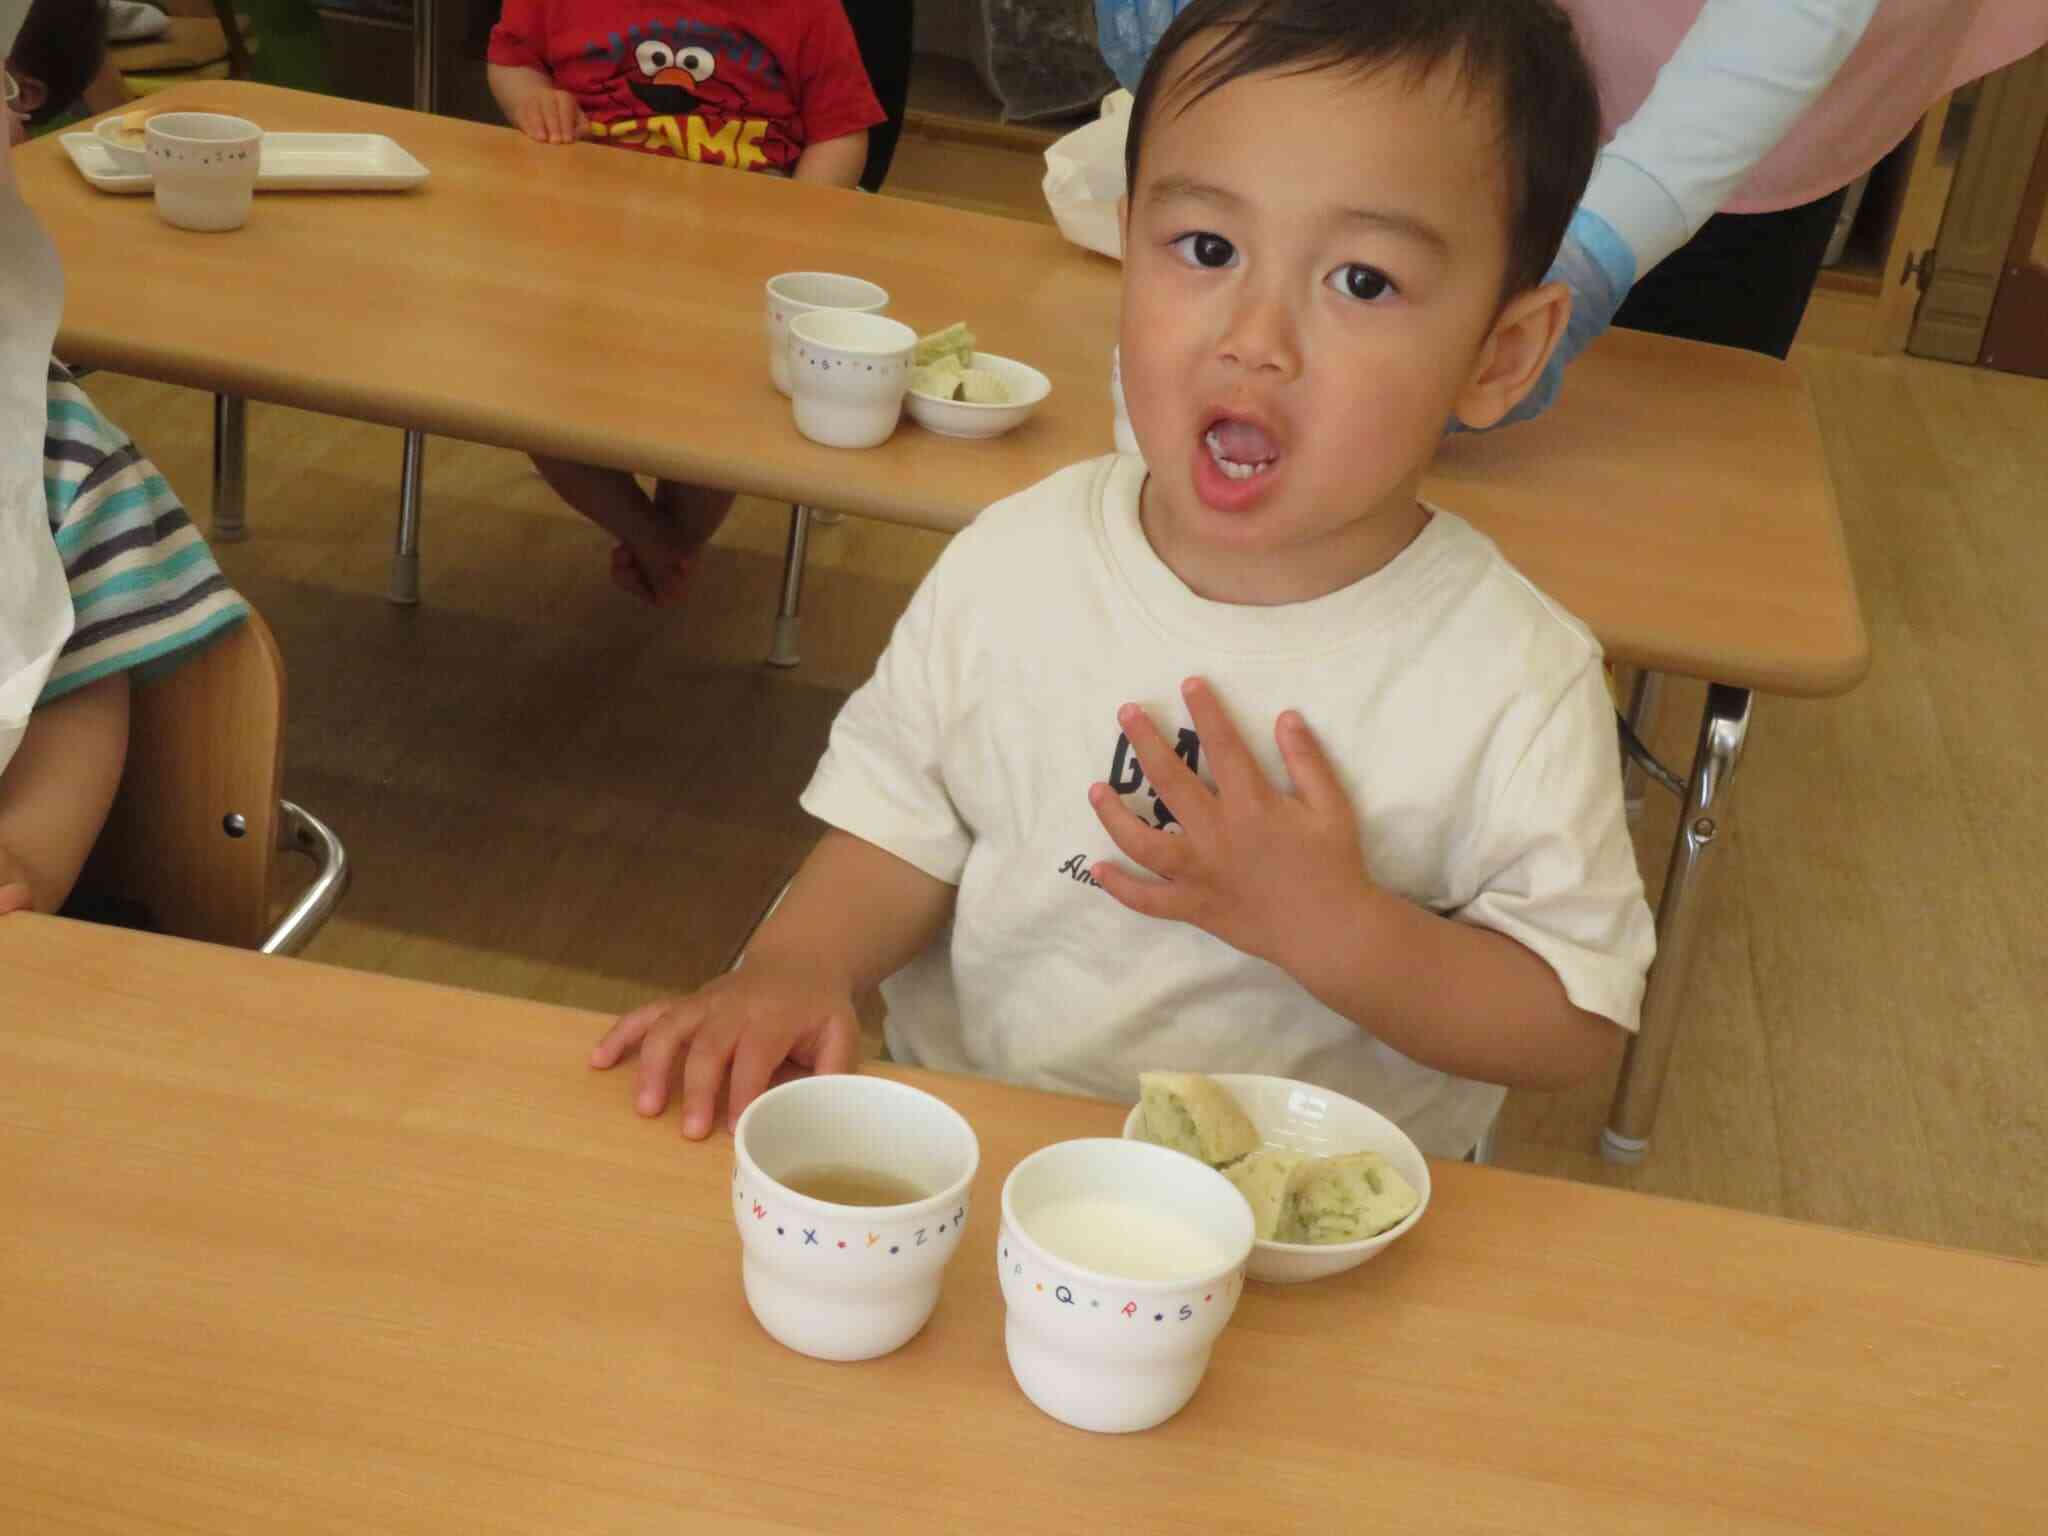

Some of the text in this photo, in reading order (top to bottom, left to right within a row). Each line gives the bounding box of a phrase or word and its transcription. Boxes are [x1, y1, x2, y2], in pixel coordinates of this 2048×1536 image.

[802, 1228, 819, 1245] X
[914, 1228, 928, 1246] Z
[1055, 1285, 1075, 1305] Q
[1120, 1301, 1137, 1318] R
[1178, 1304, 1192, 1321] S
